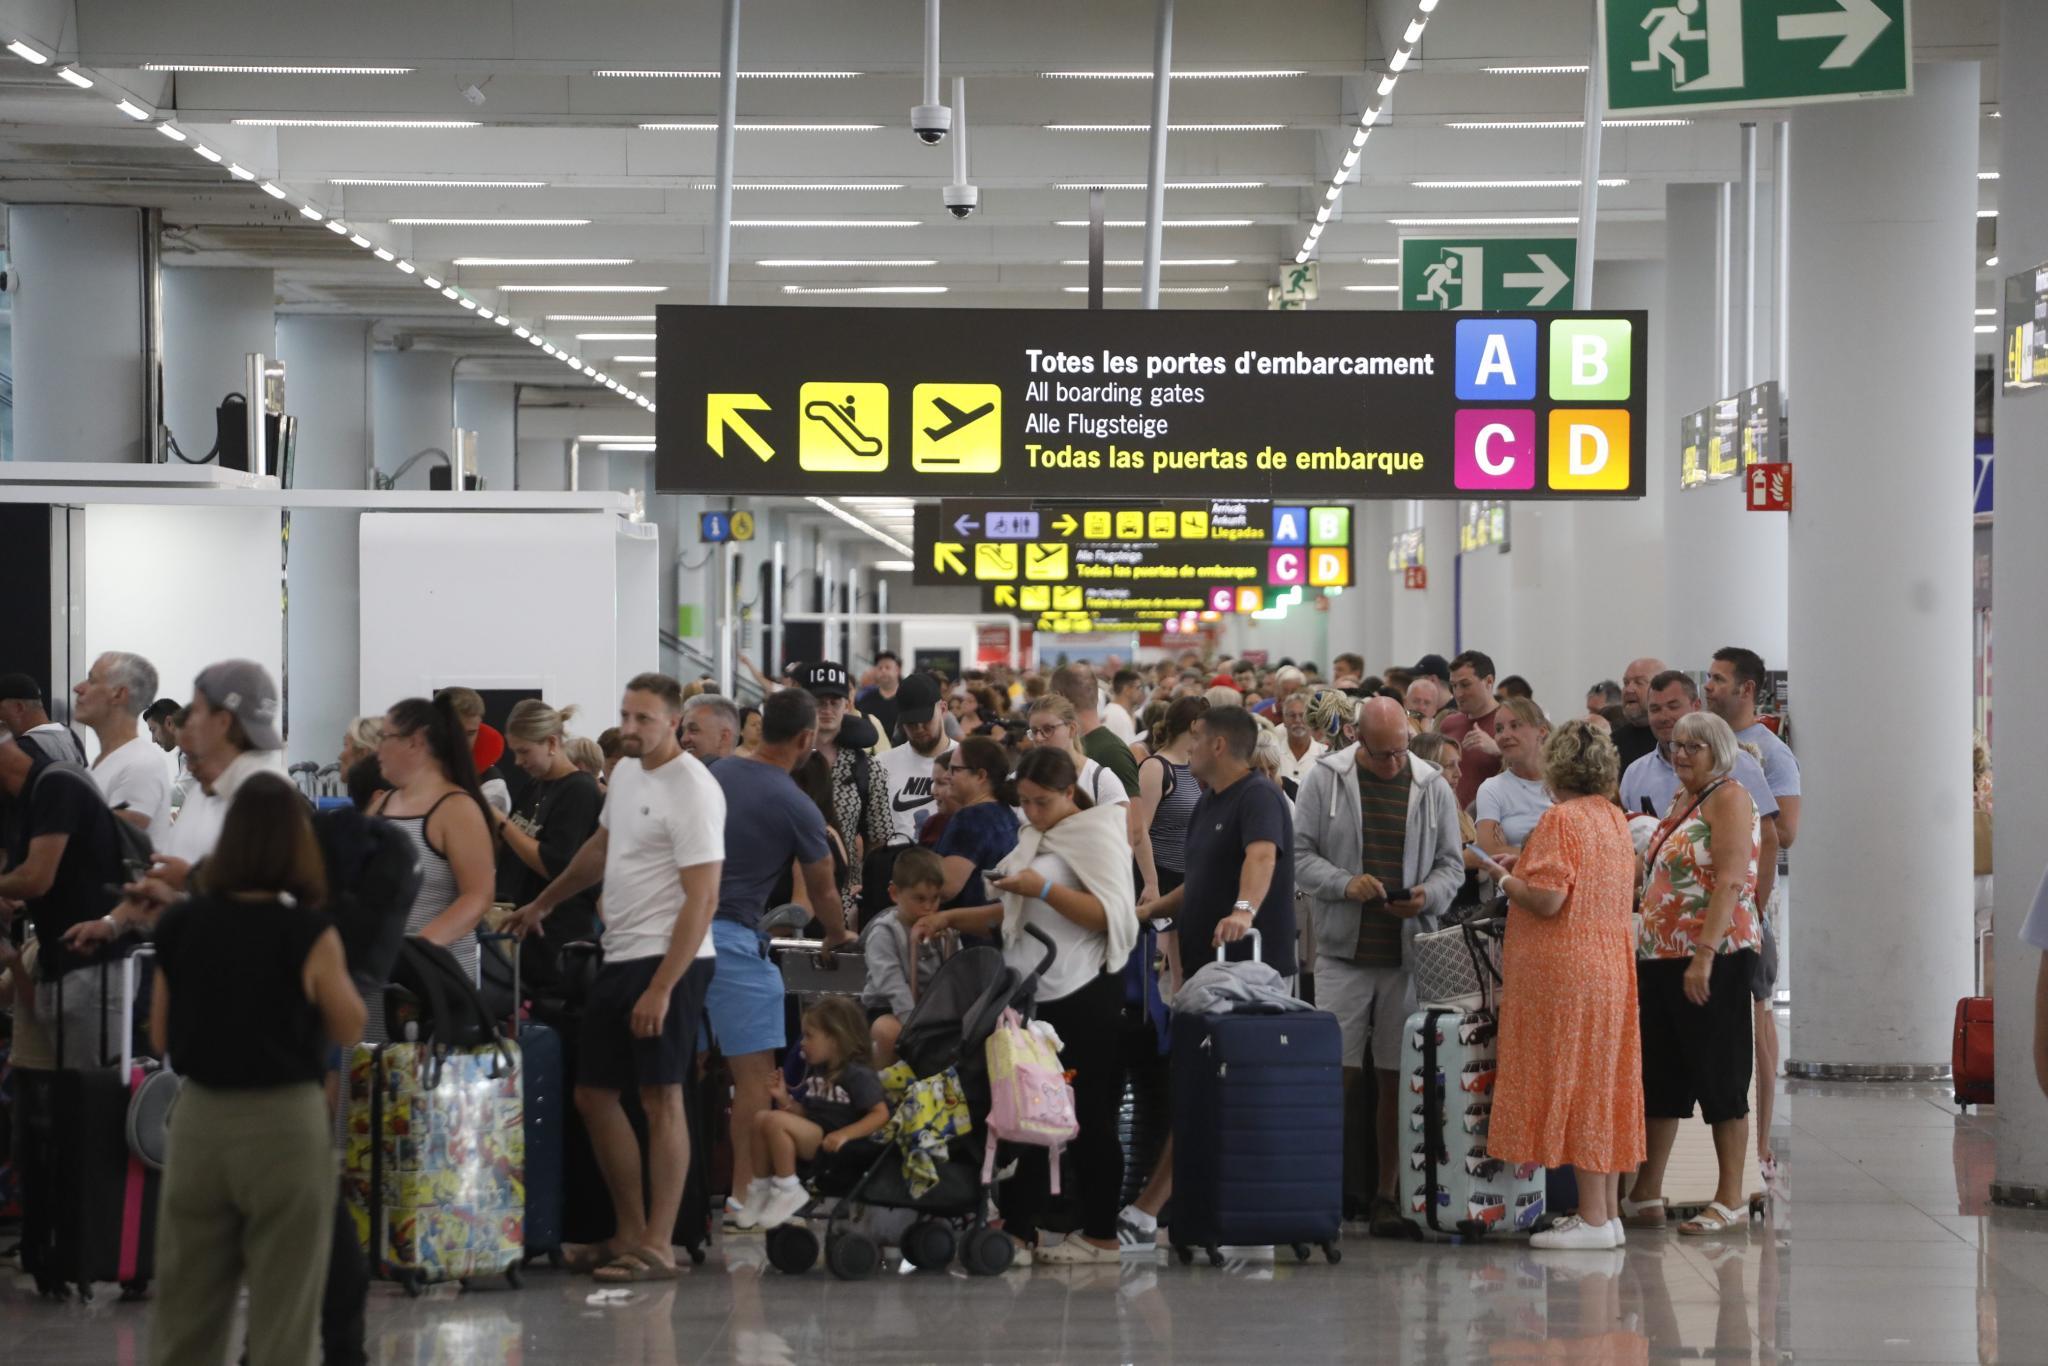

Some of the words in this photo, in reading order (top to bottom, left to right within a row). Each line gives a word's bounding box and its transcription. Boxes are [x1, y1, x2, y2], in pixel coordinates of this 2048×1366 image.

[1025, 349, 1095, 374] Totes
[1102, 349, 1139, 374] les
[1146, 352, 1227, 379] portes
[1234, 350, 1435, 376] d'embarcament
[1474, 334, 1517, 386] A
[1571, 334, 1609, 386] B
[1025, 380, 1049, 402] All
[1056, 381, 1143, 407] boarding
[1149, 384, 1205, 408] gates
[1025, 412, 1061, 434] Alle
[1068, 412, 1169, 439] Flugsteige
[1024, 444, 1101, 469] Todas
[1109, 444, 1145, 469] las
[1152, 447, 1248, 474] puertas
[1256, 445, 1288, 470] de
[1295, 446, 1425, 476] embarque
[1473, 423, 1516, 476] C
[1568, 424, 1609, 475] D
[1211, 527, 1265, 541] Llegadas
[1277, 513, 1298, 540] A
[1318, 513, 1339, 540] B
[1276, 553, 1298, 581] C
[1318, 554, 1340, 581] D
[1213, 590, 1232, 611] C
[810, 668, 846, 685] ICON
[902, 776, 935, 795] NIK
